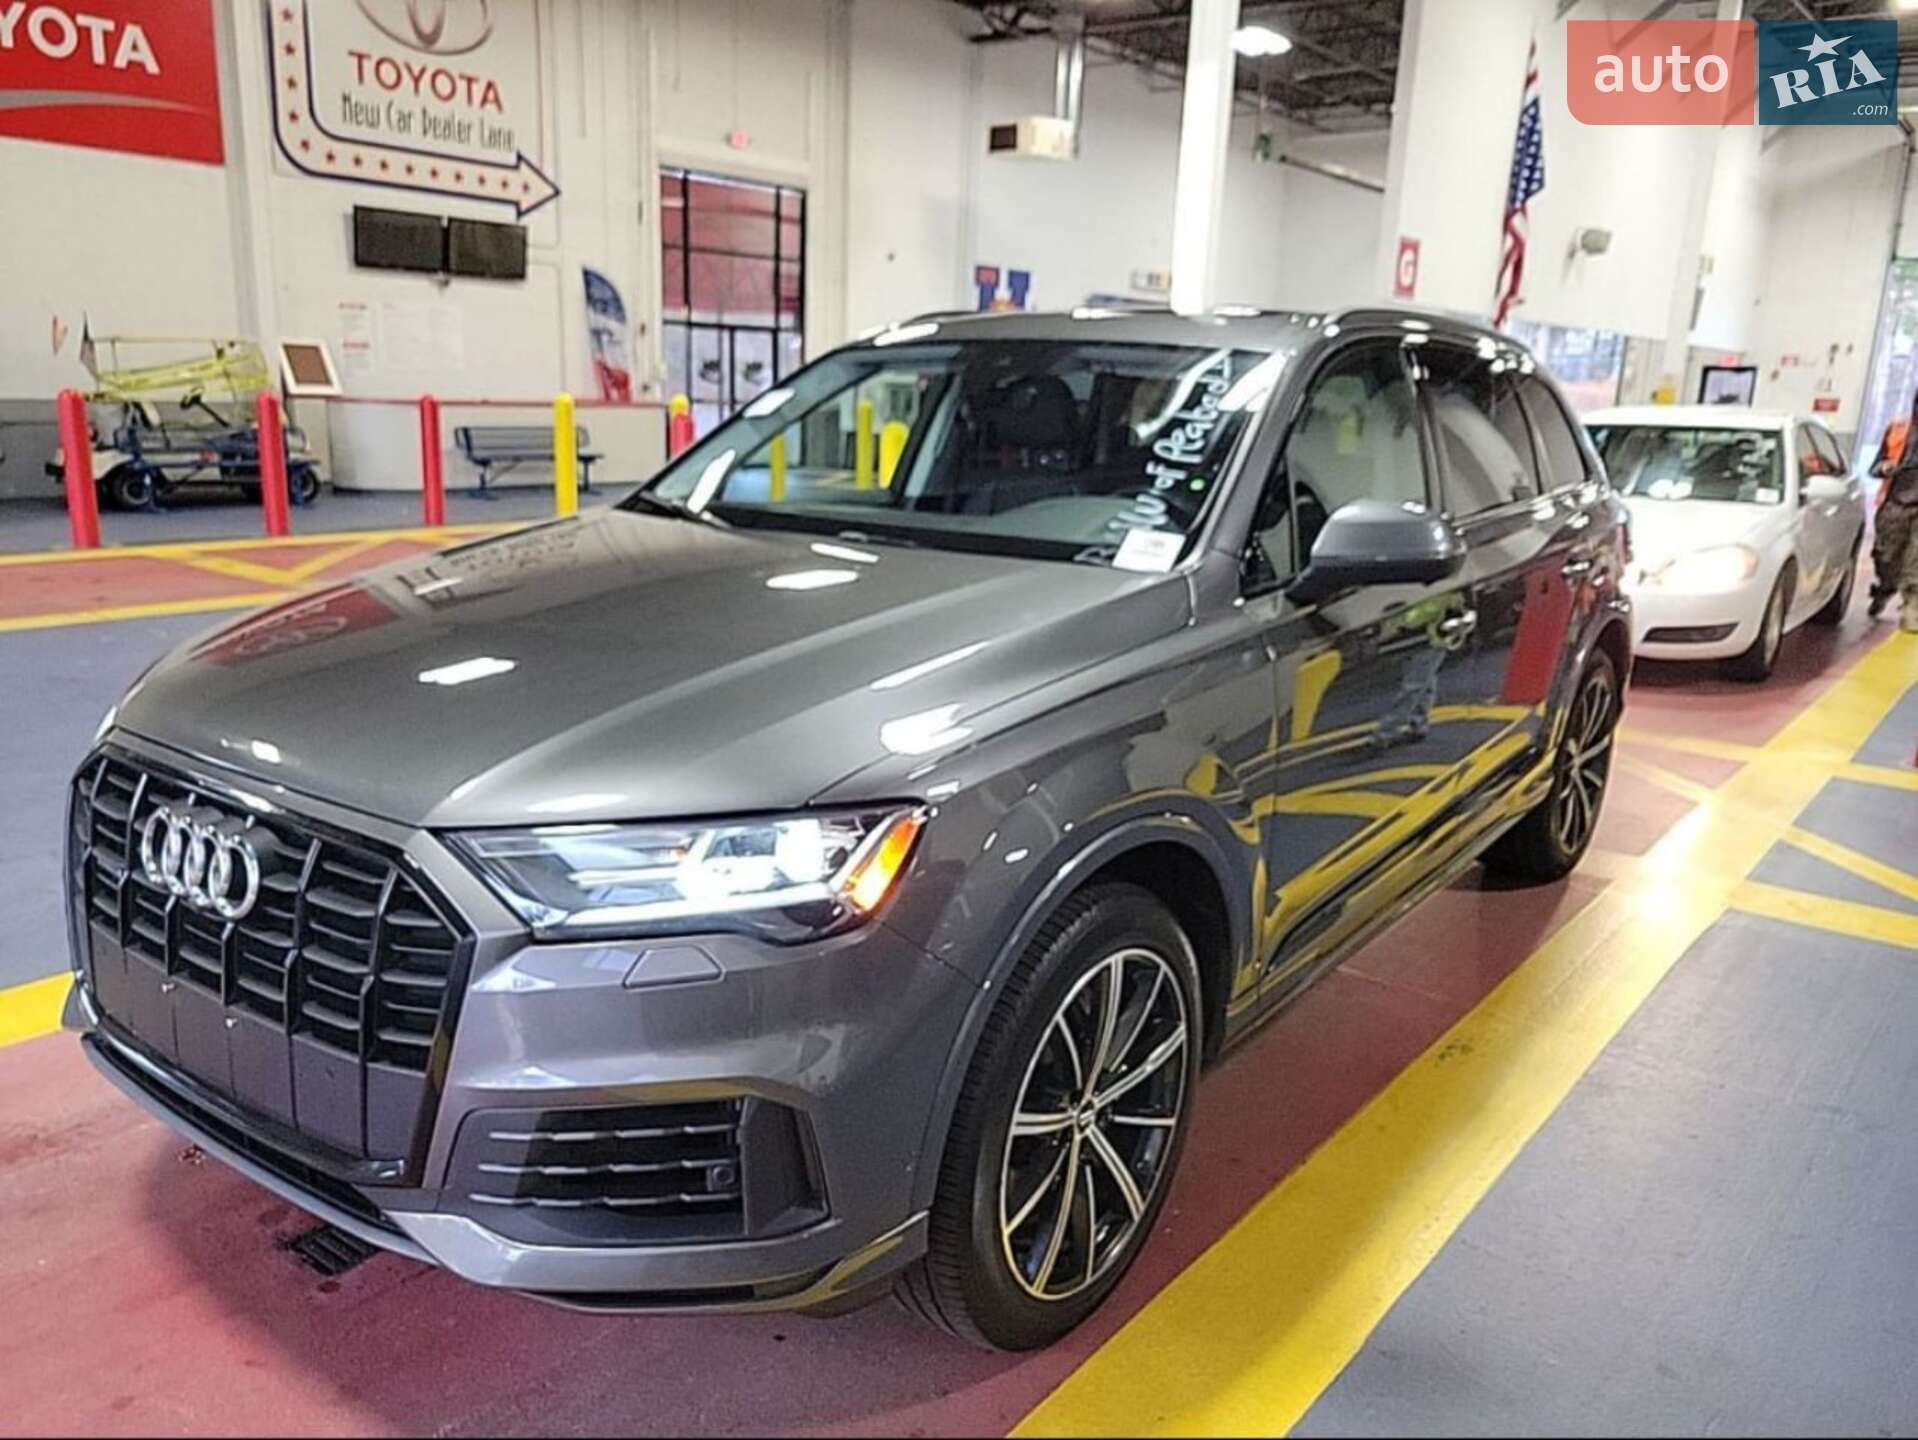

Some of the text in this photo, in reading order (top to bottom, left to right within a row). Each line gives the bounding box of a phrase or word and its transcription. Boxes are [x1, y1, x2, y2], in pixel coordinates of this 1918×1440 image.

[348, 50, 504, 113] TOYOTA
[341, 94, 517, 150] New Car Dealer Lane
